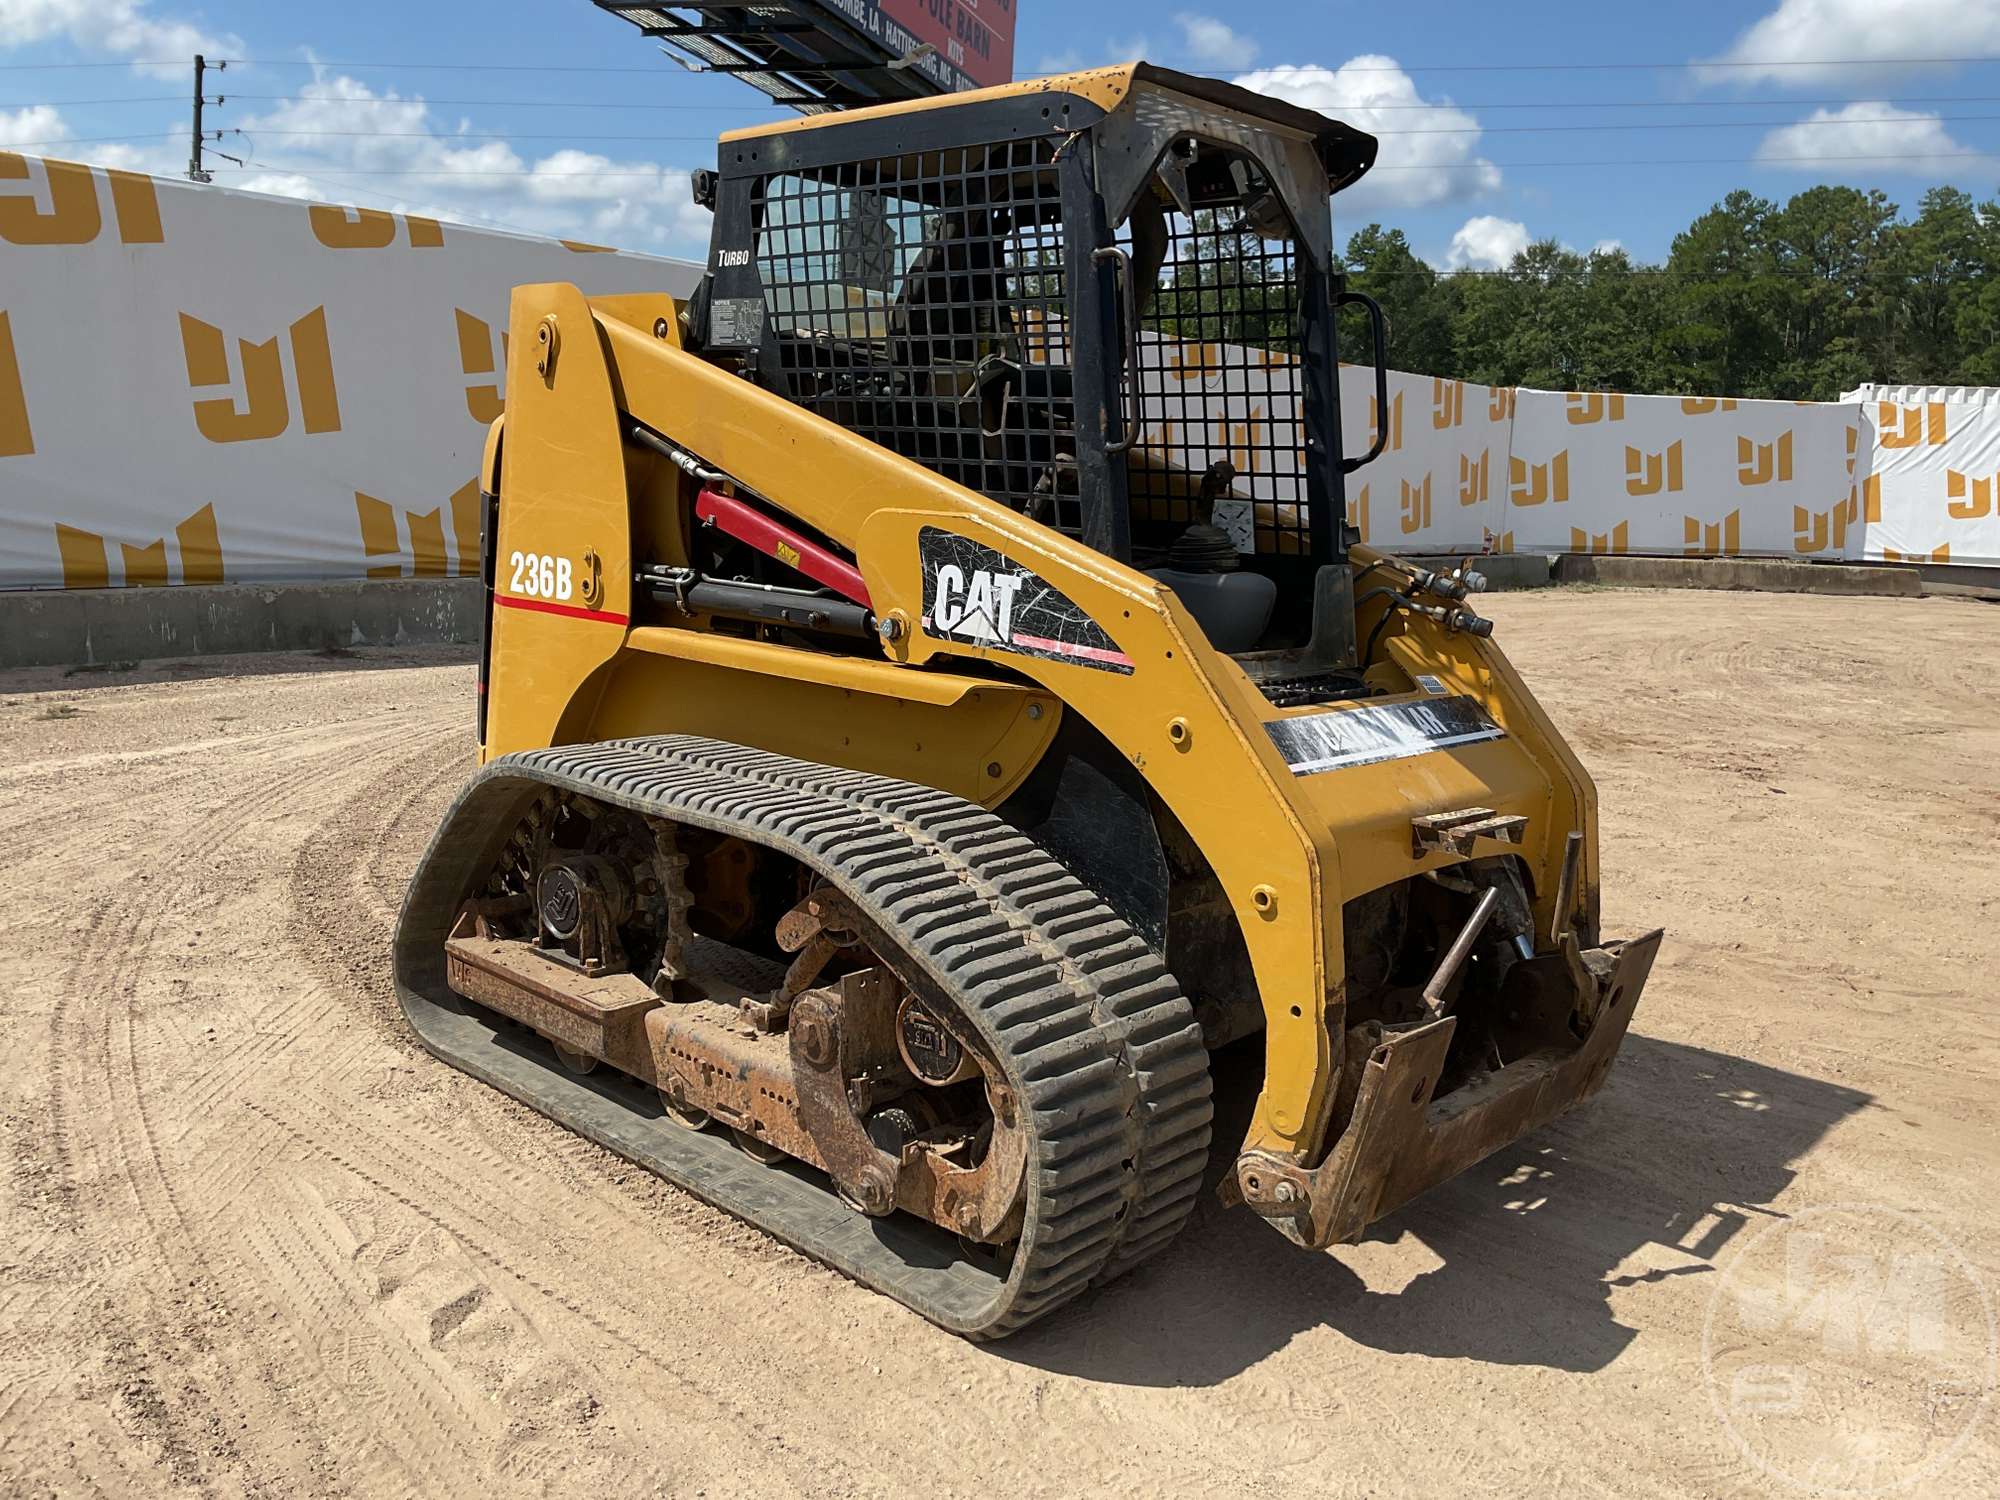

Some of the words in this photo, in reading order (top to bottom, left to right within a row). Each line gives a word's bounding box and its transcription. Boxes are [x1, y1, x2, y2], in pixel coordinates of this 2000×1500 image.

[917, 0, 952, 32] OLE
[869, 7, 880, 36] LA
[940, 60, 952, 86] MS
[718, 249, 749, 267] TURBO
[510, 551, 572, 600] 236B
[934, 564, 1022, 643] CAT
